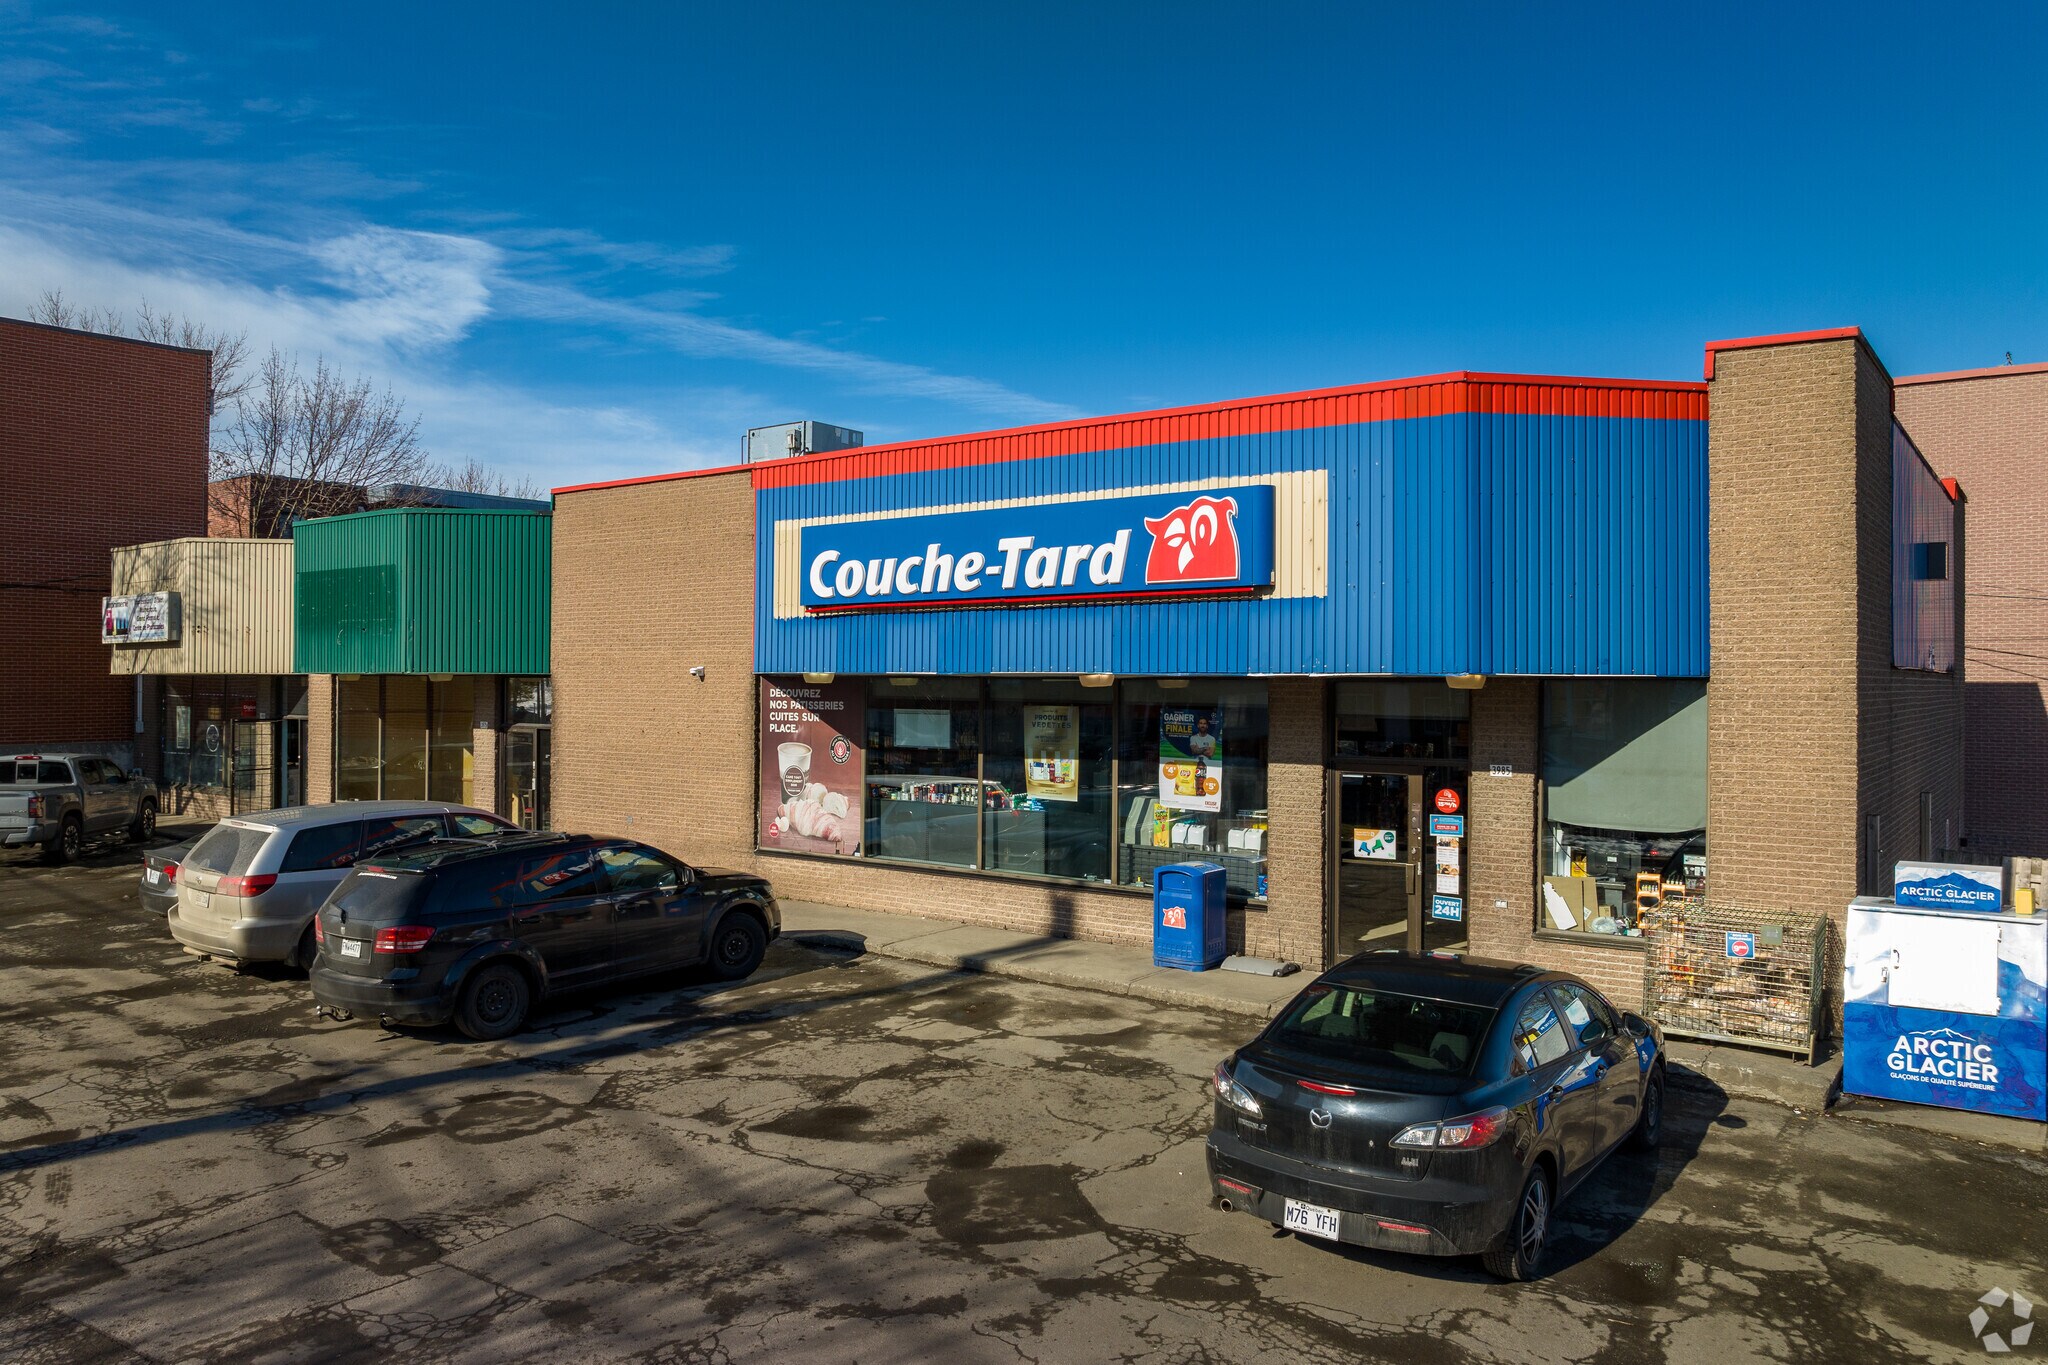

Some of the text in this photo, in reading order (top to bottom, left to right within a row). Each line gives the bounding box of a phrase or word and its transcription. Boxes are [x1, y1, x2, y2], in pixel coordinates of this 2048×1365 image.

[809, 529, 1132, 598] Couche-Tard
[769, 686, 821, 698] DÉCOUVREZ
[769, 698, 844, 710] NOS PÂTISSERIES
[769, 712, 820, 722] CUITES SUR
[1164, 713, 1195, 722] GAGNER
[769, 723, 799, 733] PLACE.
[1165, 724, 1193, 733] FINALE
[1491, 765, 1511, 776] 3985
[1901, 887, 1995, 901] ARCTIC GLACIER
[1435, 899, 1459, 907] OUVERT
[1434, 905, 1459, 918] 24H
[1893, 1035, 1992, 1063] ARCTIC
[1887, 1052, 1999, 1083] GLACIER
[1890, 1072, 1919, 1081] GLAÇONS
[1930, 1077, 1957, 1087] QUALITÉ
[1957, 1080, 1996, 1091] SUPÉRIEURE
[1286, 1206, 1337, 1233] M76 YFH
